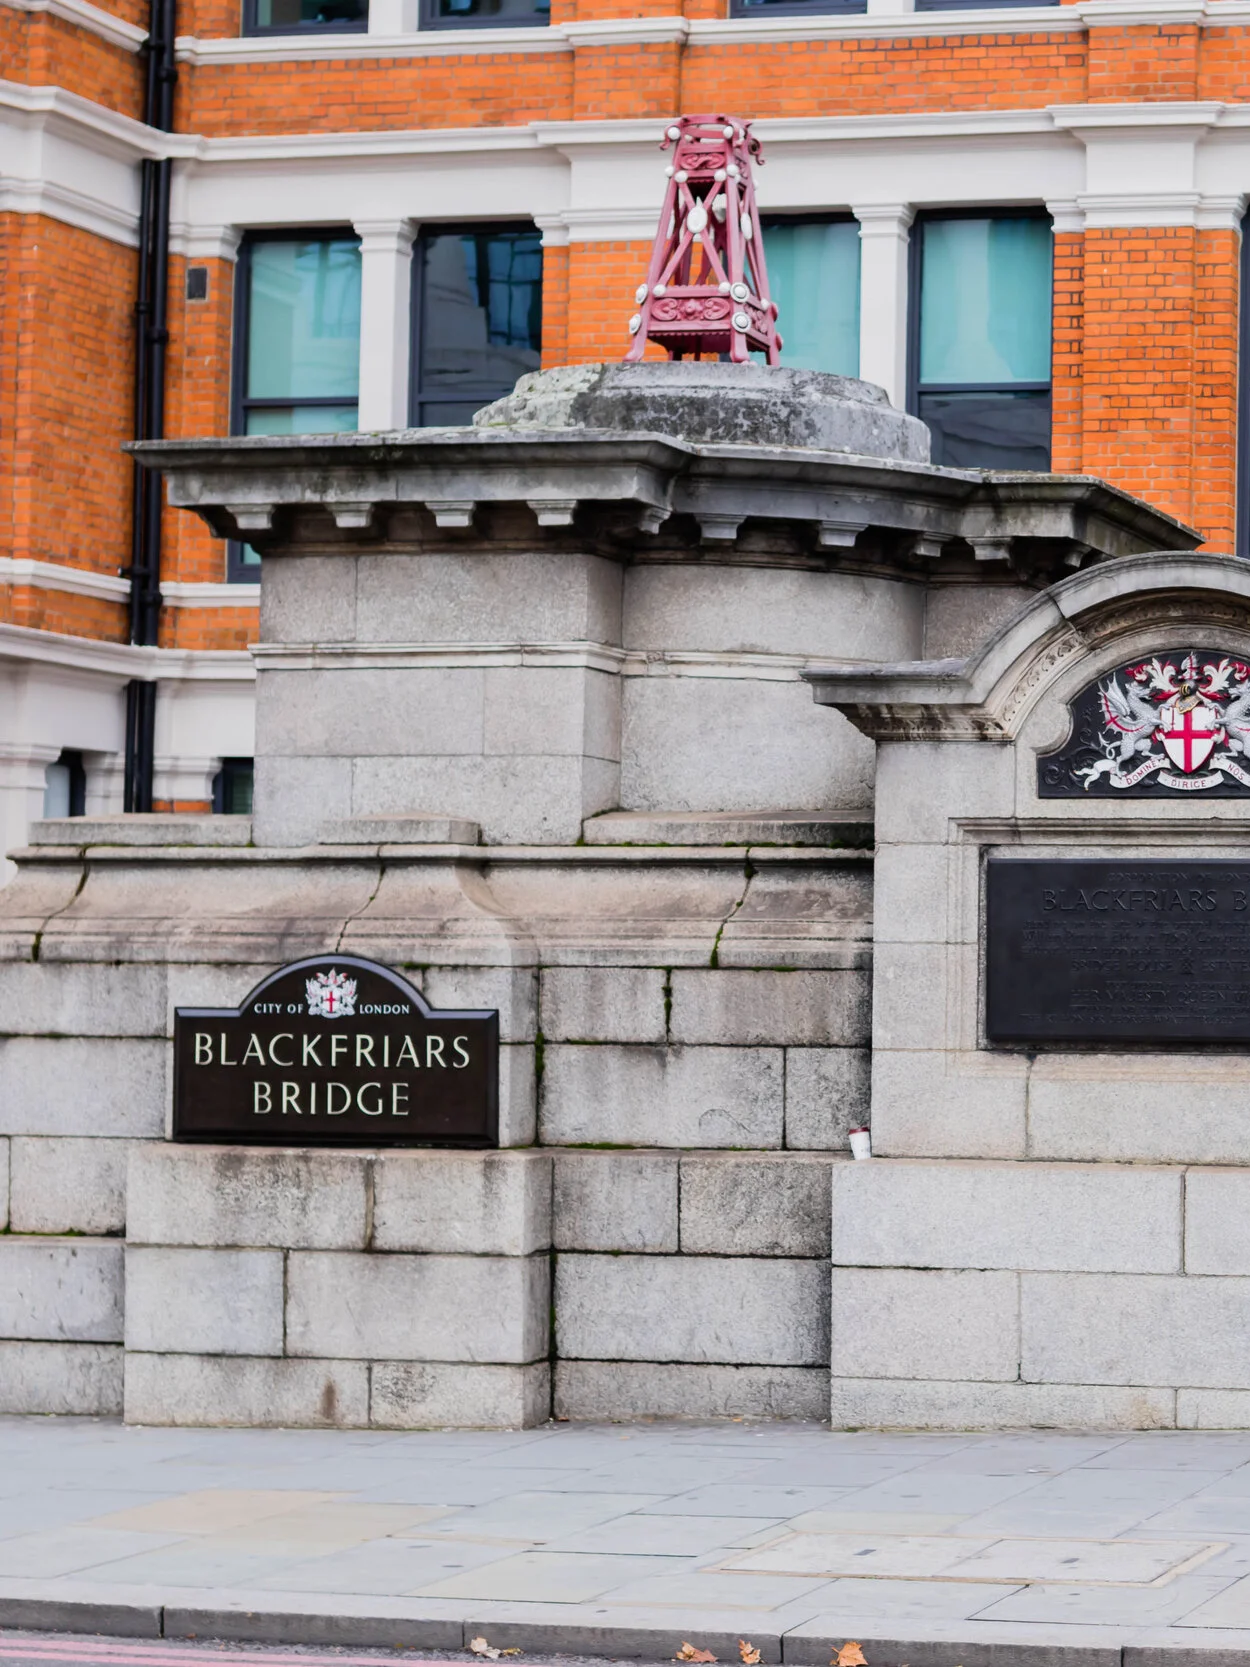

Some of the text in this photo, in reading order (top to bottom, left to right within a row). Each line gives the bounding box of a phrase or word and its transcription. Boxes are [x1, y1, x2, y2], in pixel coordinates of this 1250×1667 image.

[1125, 759, 1158, 786] DOMINE
[1227, 763, 1246, 782] NOS
[1042, 888, 1217, 912] BLACKFRIARS
[254, 1003, 410, 1015] CITY OF LONDON
[194, 1032, 470, 1068] BLACKFRIARS
[253, 1081, 409, 1116] BRIDGE
